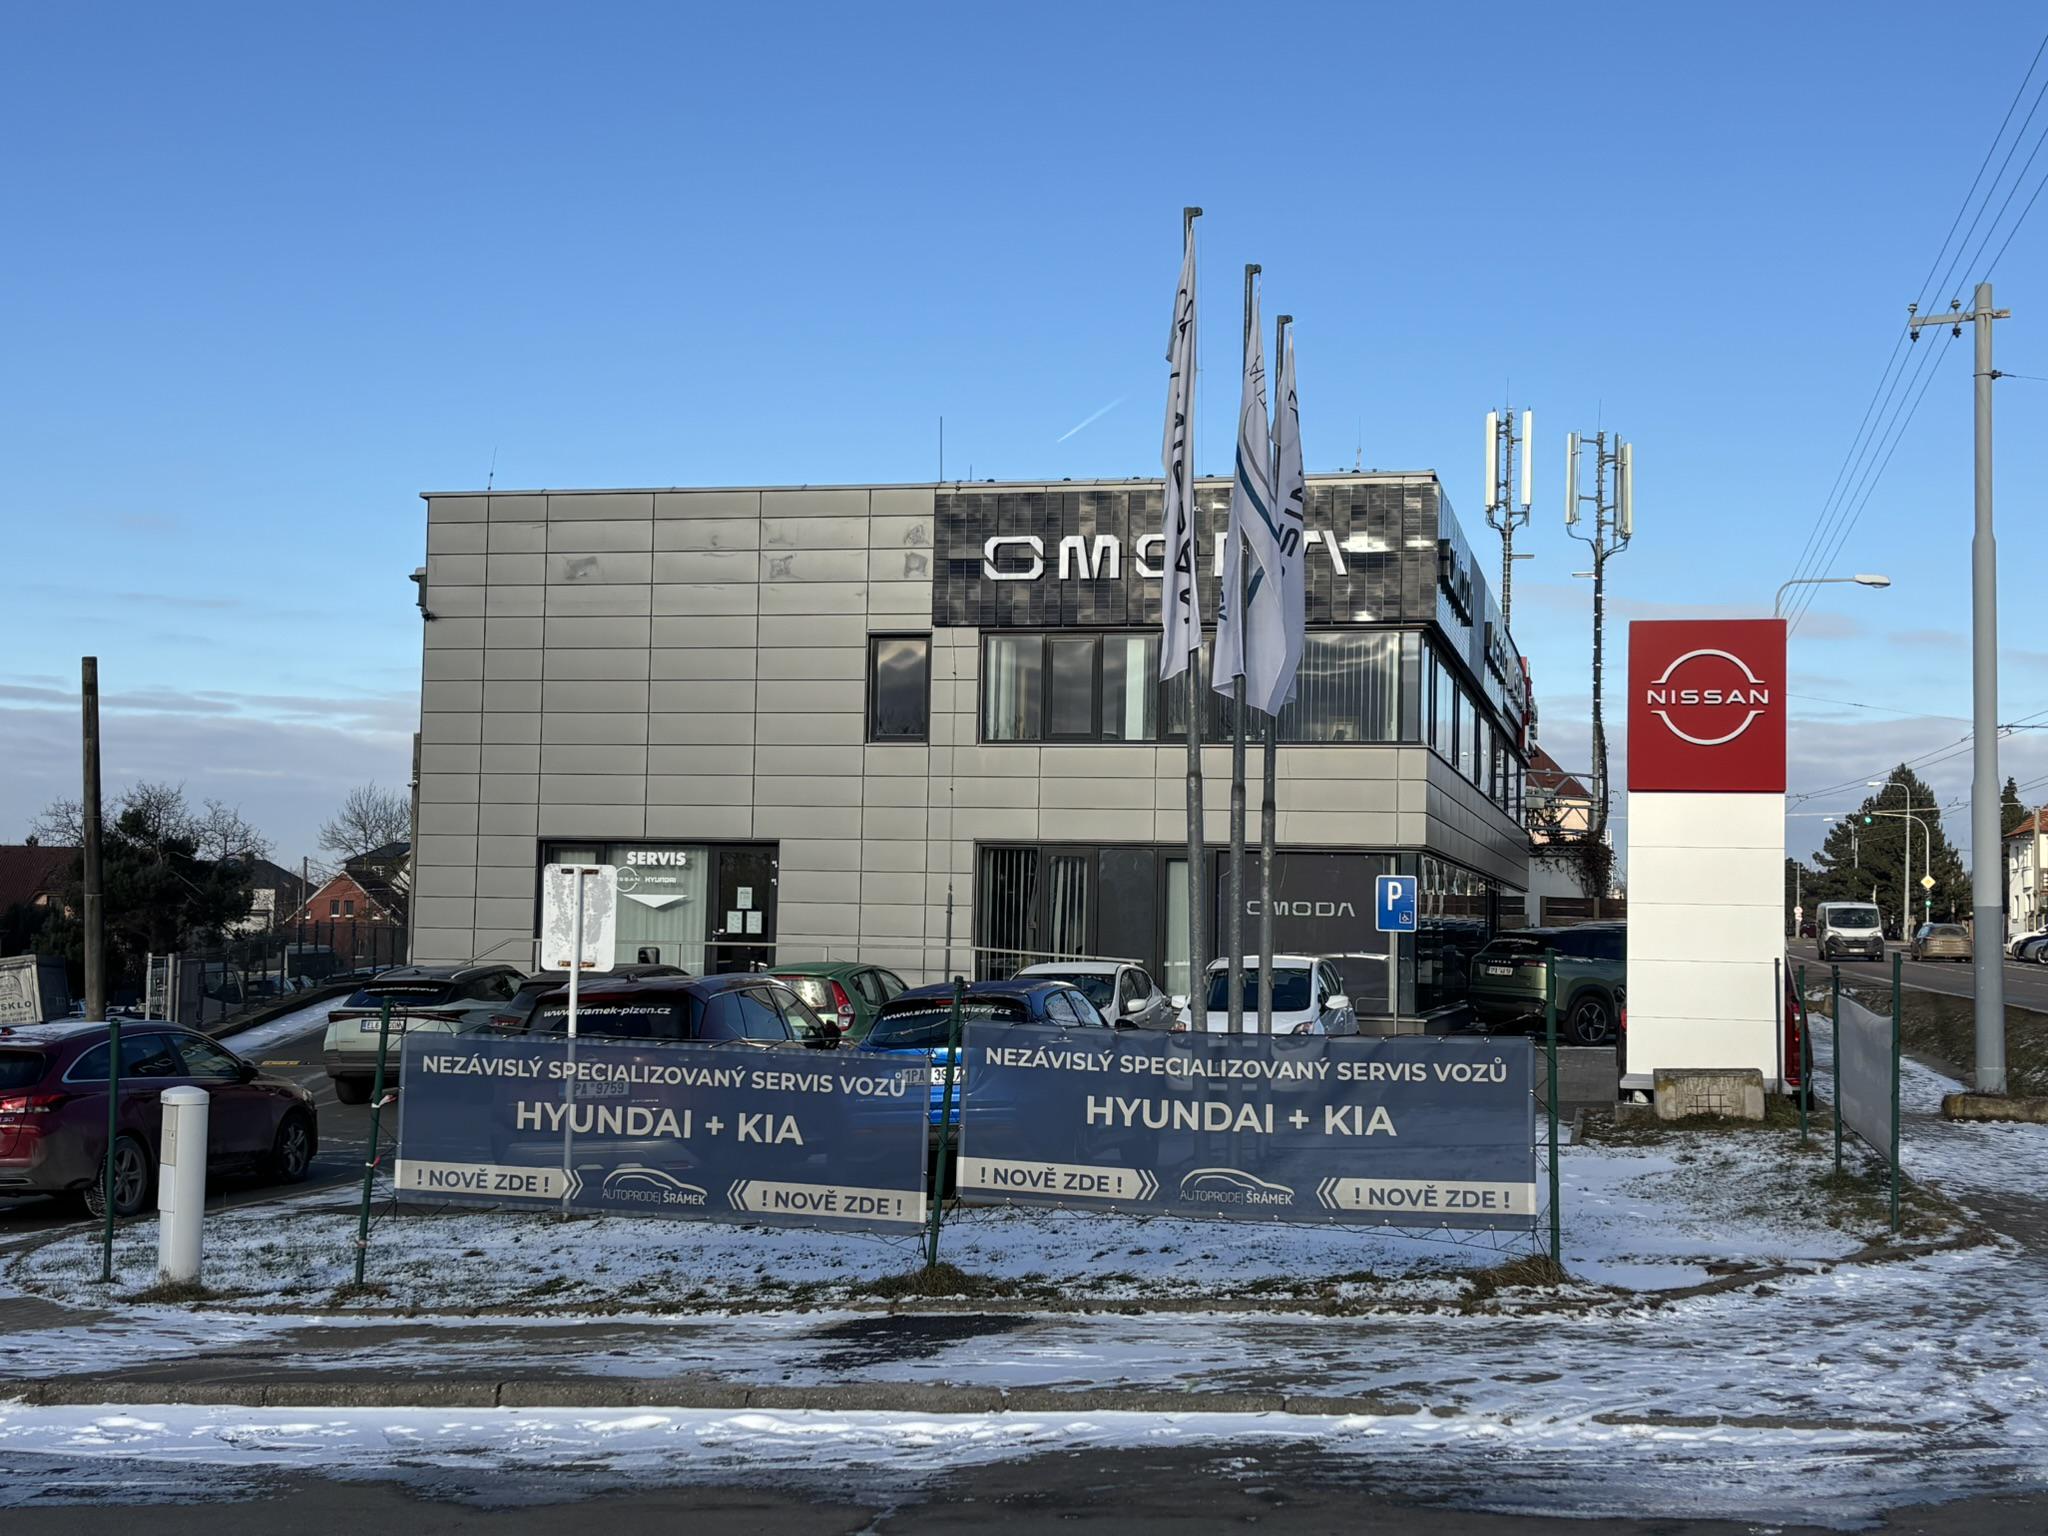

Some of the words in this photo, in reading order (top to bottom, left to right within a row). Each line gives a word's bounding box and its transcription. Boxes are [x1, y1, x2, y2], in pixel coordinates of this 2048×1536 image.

[1647, 689, 1769, 705] NISSAN
[626, 851, 686, 865] SERVIS
[645, 876, 677, 884] HYUNDAI
[1388, 882, 1401, 911] P
[422, 1054, 542, 1078] NEZÁVISLÝ
[548, 1059, 745, 1089] SPECIALIZOVANÝ
[751, 1072, 832, 1093] SERVIS
[840, 1072, 906, 1097] VOZŮ
[986, 1046, 1112, 1071] NEZÁVISLÝ
[1120, 1054, 1330, 1081] SPECIALIZOVANÝ
[1336, 1062, 1426, 1082] SERVIS
[1433, 1056, 1508, 1083] VOZŮ
[516, 1101, 692, 1139] HYUNDAI
[704, 1115, 724, 1136] +
[738, 1113, 804, 1145] KIA
[1086, 1095, 1274, 1133] HYUNDAI
[1288, 1109, 1310, 1130] +
[1325, 1106, 1397, 1136] KIA
[428, 1169, 489, 1189] NOVĚ
[494, 1172, 538, 1192] ZDE
[993, 1167, 1056, 1188] NOVĚ
[1062, 1172, 1109, 1192] ZDE
[602, 1189, 661, 1204] AUTOPRODEJ
[663, 1191, 705, 1205] ŠRÁMEK
[774, 1187, 837, 1211] NOVĚ
[842, 1193, 890, 1215] ZDE
[1180, 1190, 1243, 1205] AUTOPRODEJ
[1247, 1191, 1292, 1205] ŠRÁMEK
[1368, 1183, 1439, 1206] NOVĚ
[1446, 1188, 1496, 1208] ZDE
